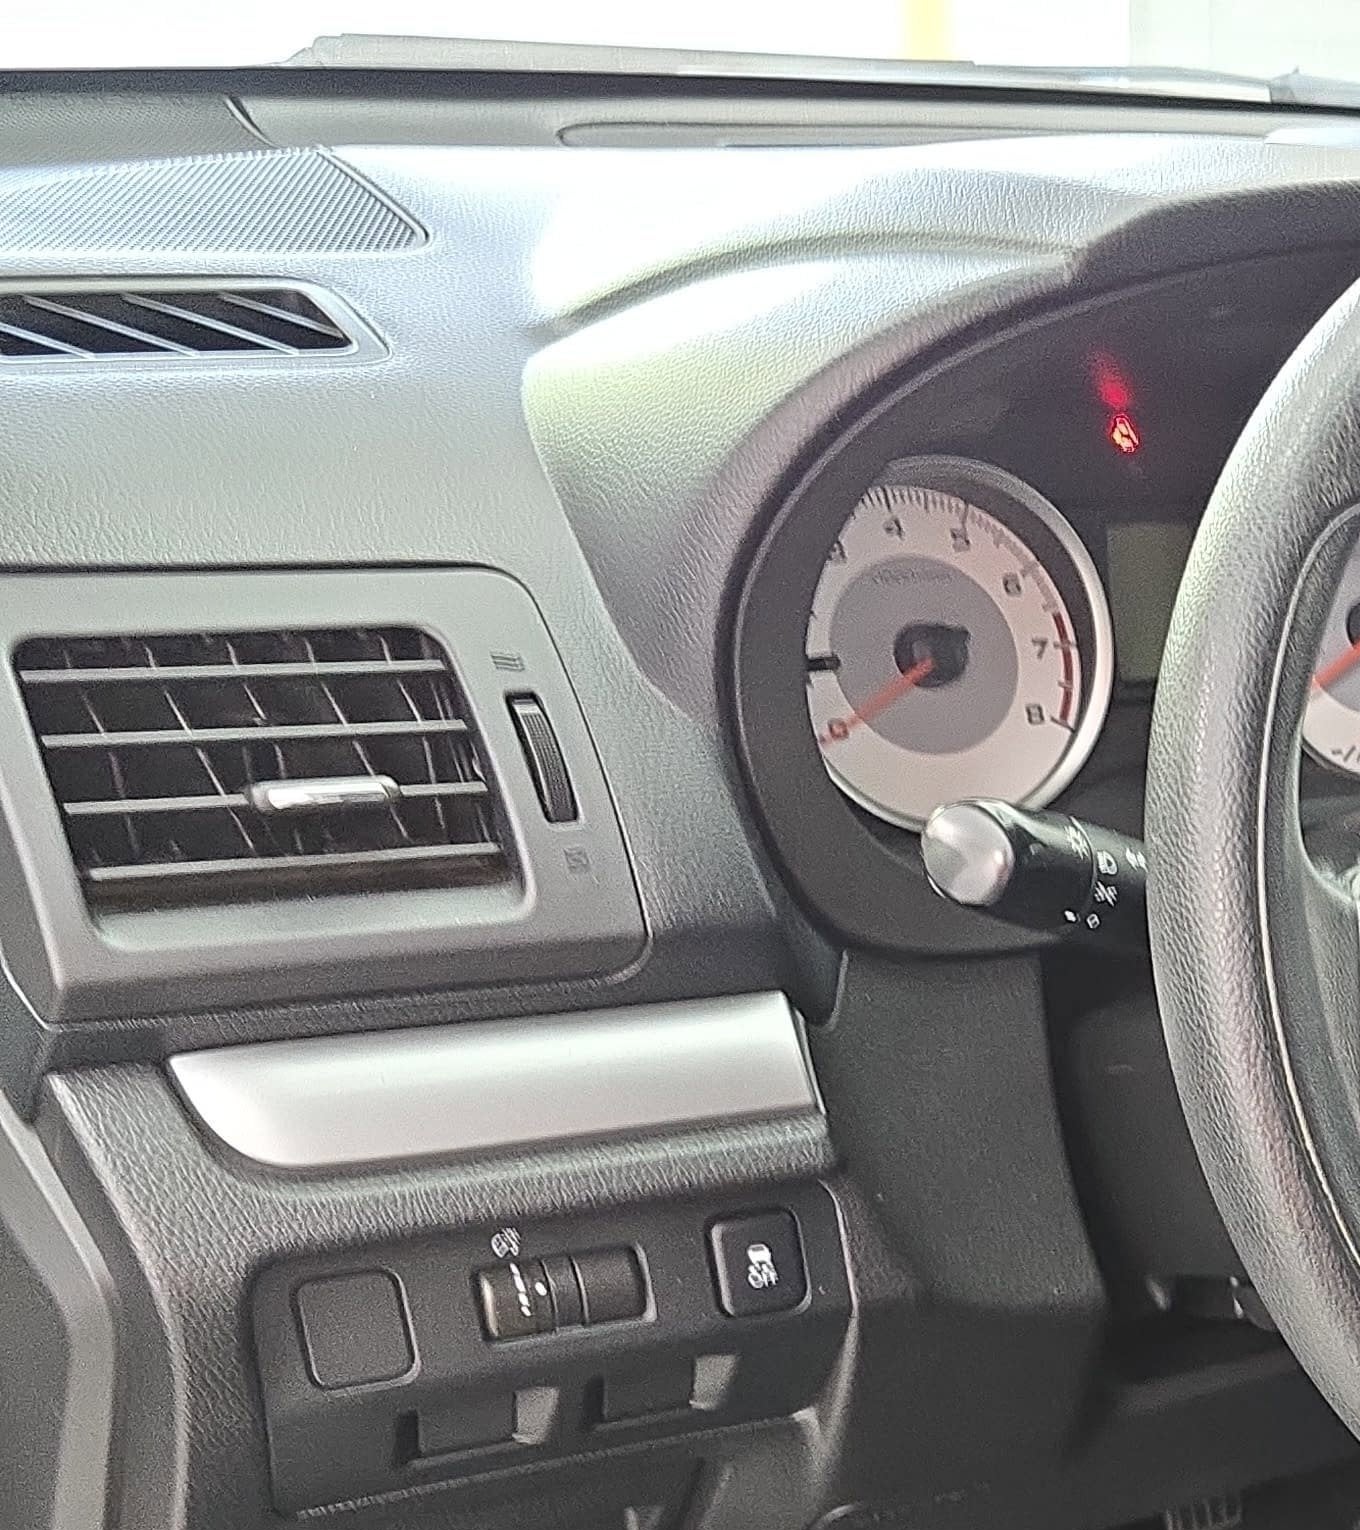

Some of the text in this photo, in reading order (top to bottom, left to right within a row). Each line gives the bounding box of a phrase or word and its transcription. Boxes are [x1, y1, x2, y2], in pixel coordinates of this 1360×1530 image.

[886, 517, 905, 540] 4
[1031, 635, 1048, 660] 7
[1025, 703, 1045, 726] 8
